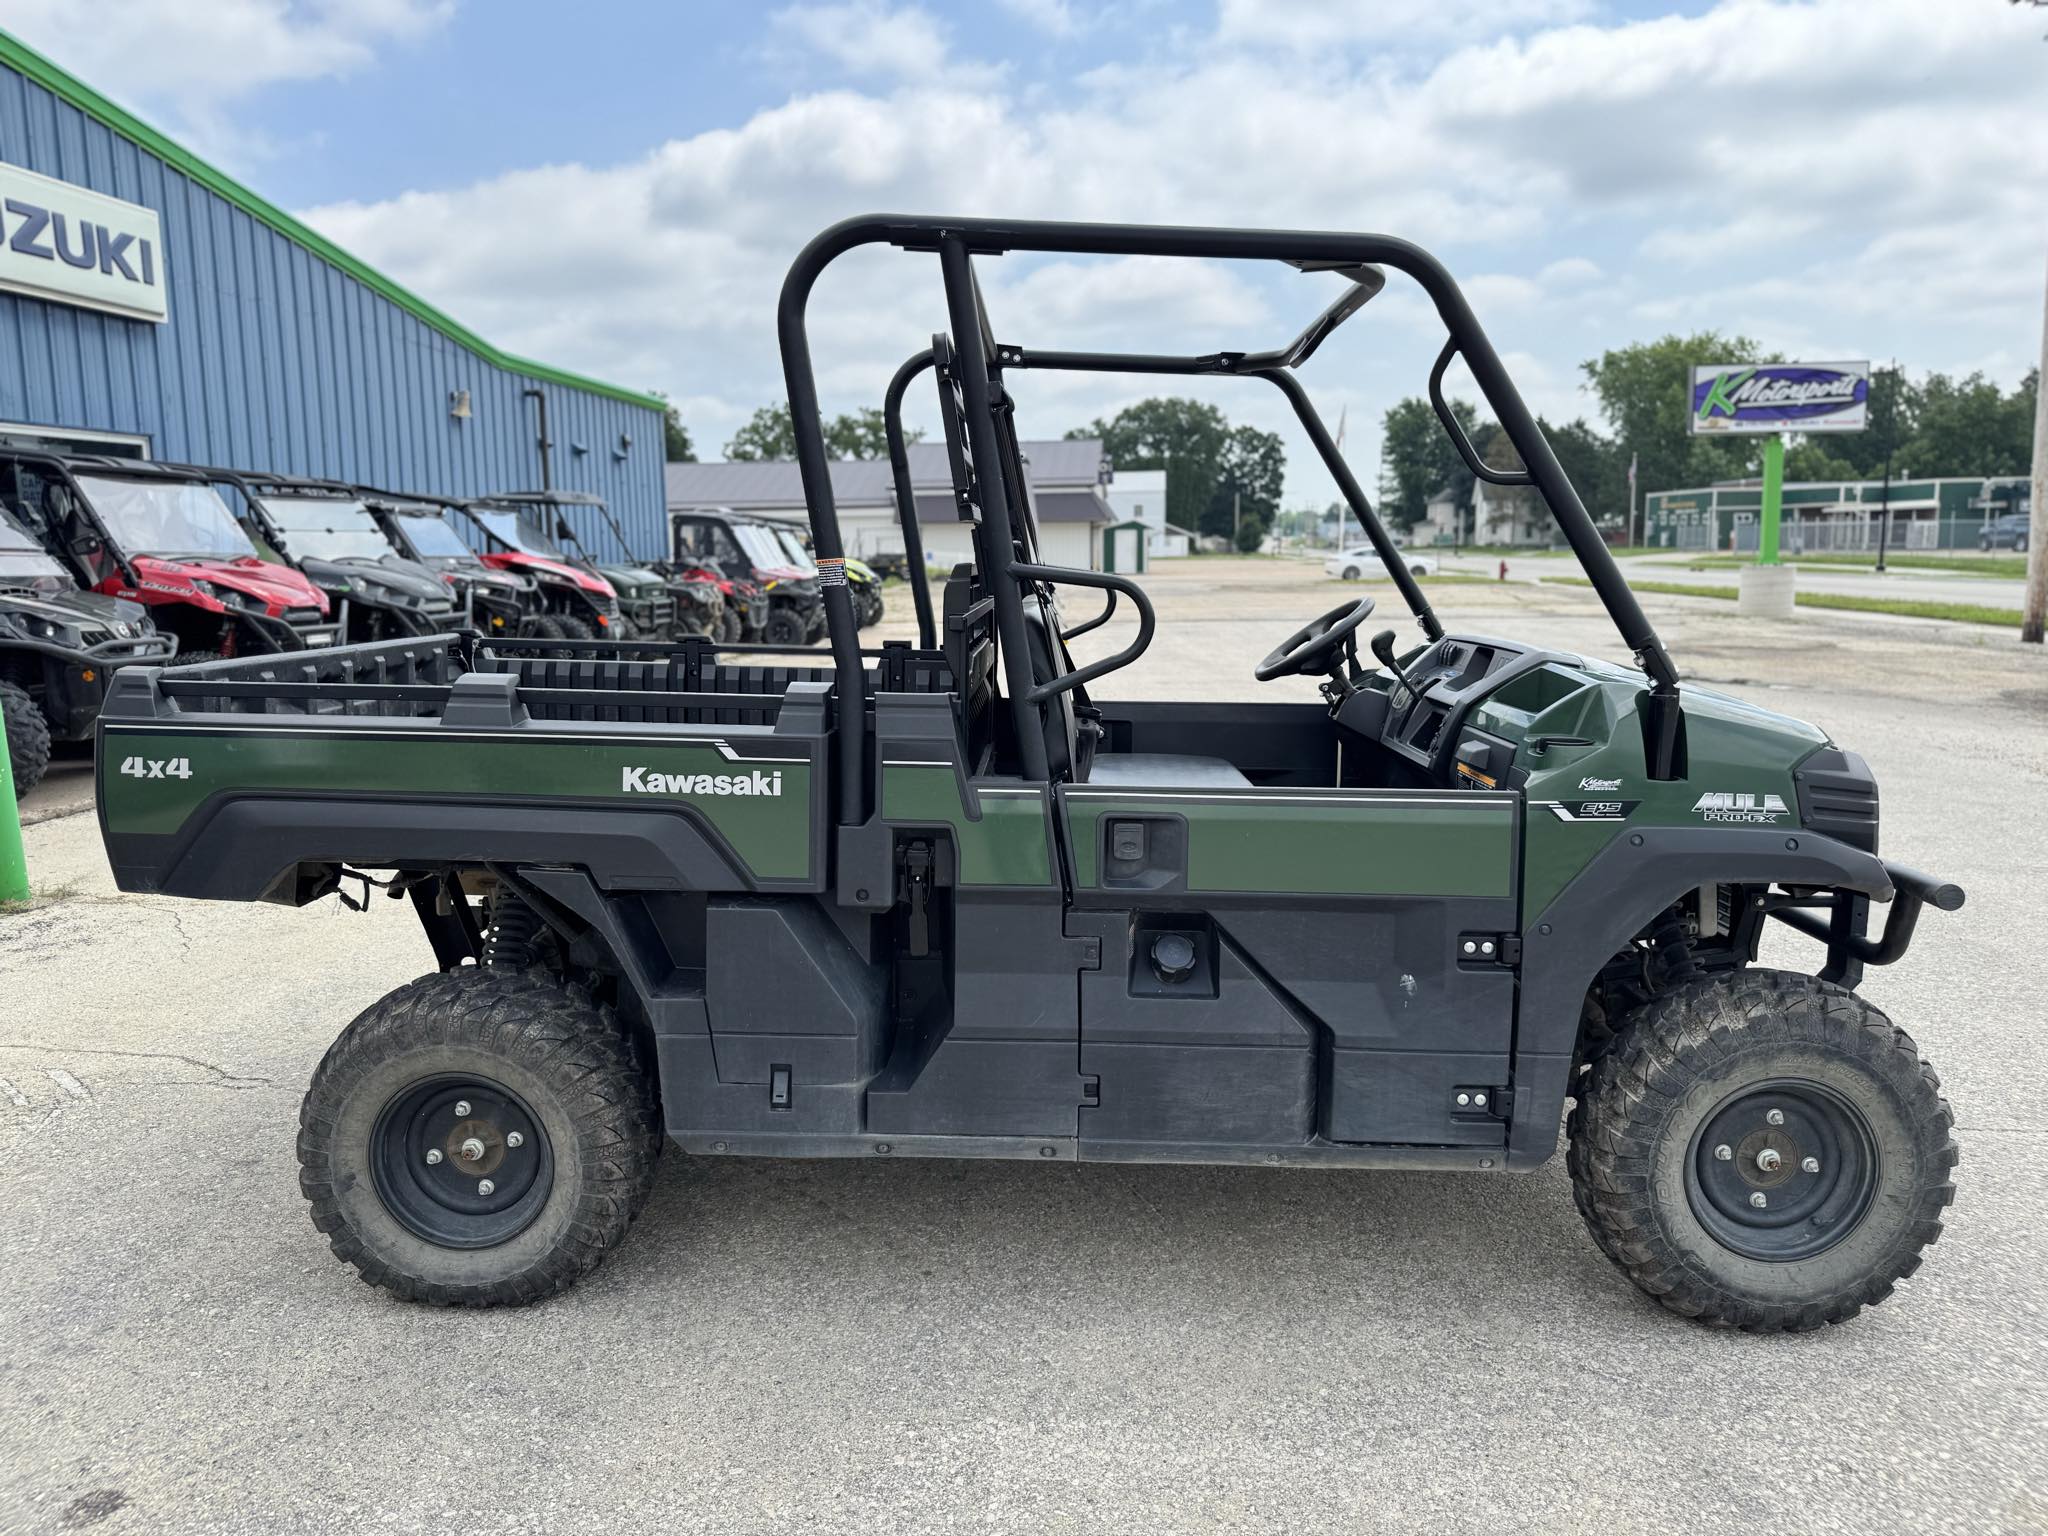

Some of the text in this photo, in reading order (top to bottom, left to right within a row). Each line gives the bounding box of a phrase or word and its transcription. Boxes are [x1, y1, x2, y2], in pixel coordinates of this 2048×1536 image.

[0, 197, 155, 286] ZUKI
[1700, 367, 1757, 419] K
[120, 756, 193, 779] 4x4
[622, 766, 782, 796] Kawasaki
[1691, 793, 1790, 815] MULE
